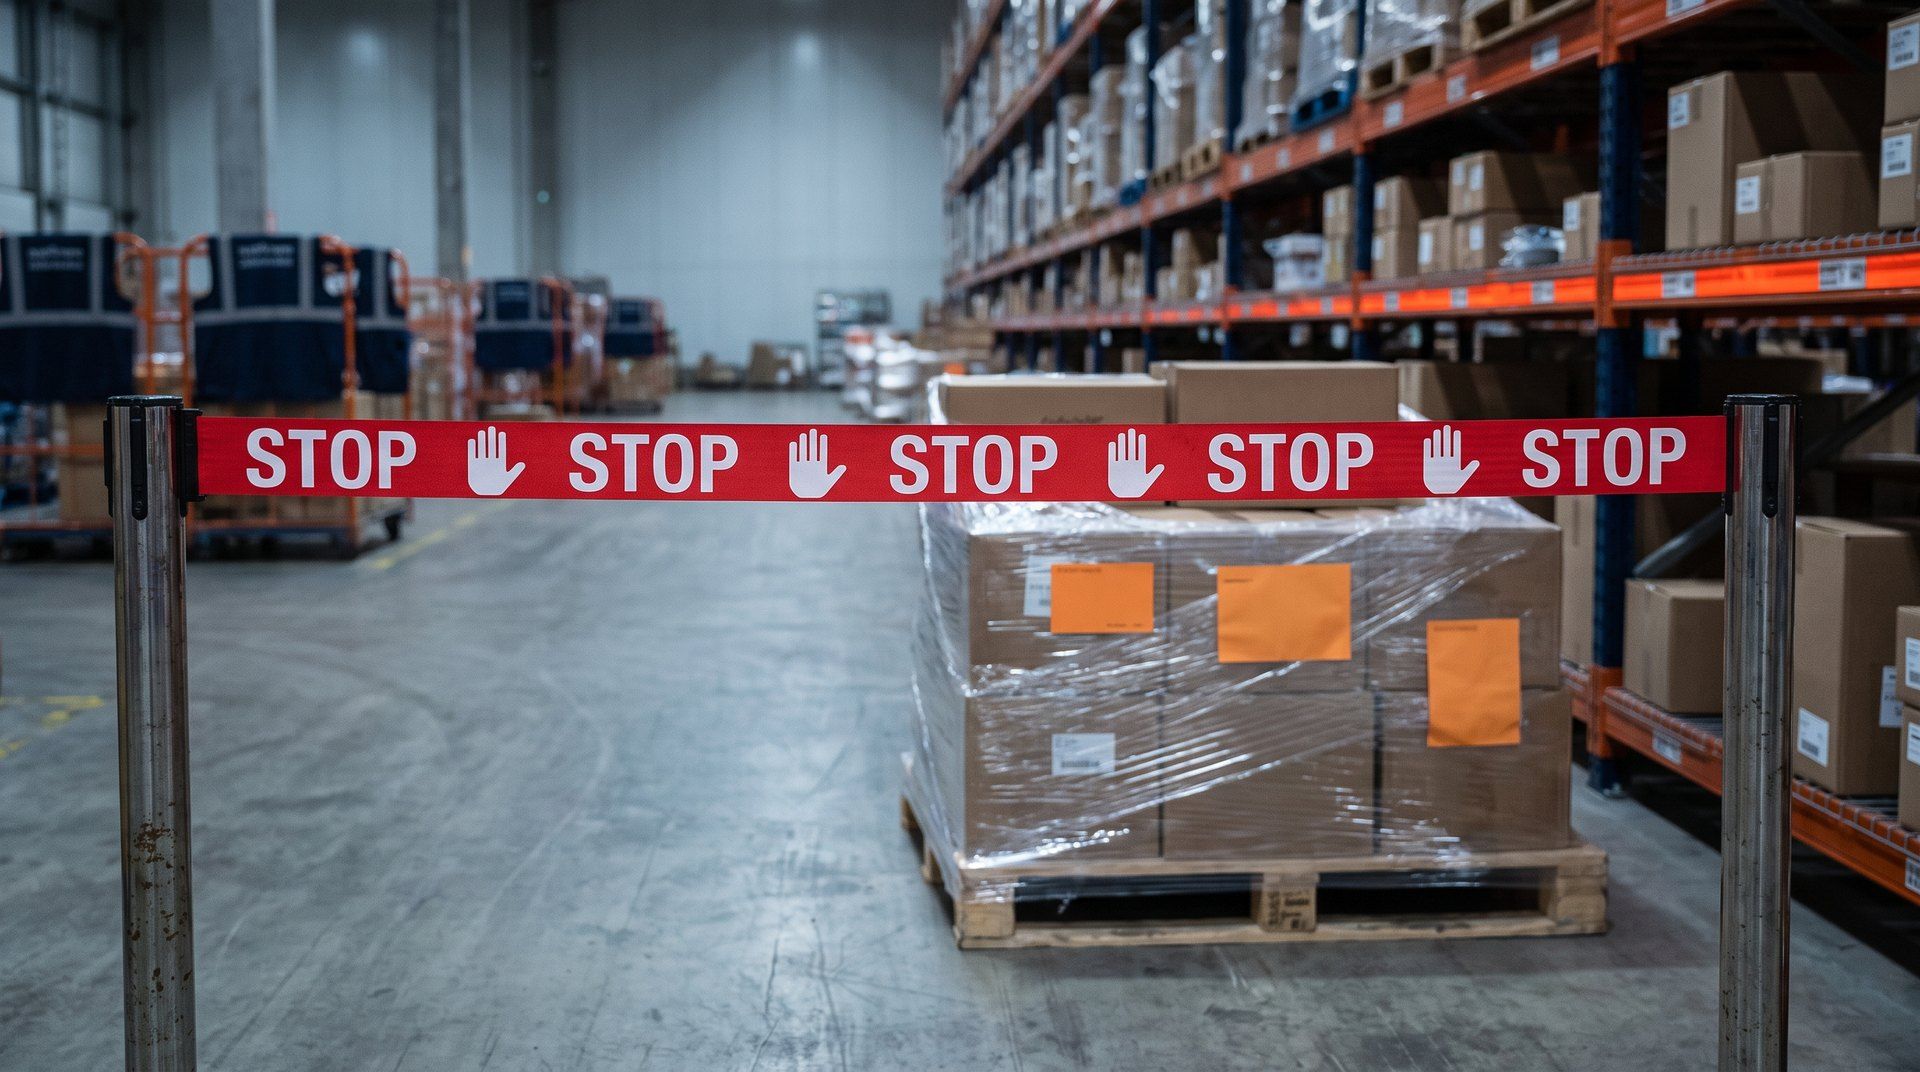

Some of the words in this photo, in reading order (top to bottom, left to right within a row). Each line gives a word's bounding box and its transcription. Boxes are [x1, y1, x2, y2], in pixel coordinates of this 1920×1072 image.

[246, 427, 417, 490] STOP
[568, 432, 739, 494] STOP
[889, 434, 1058, 495] STOP
[1207, 432, 1374, 493] STOP
[1522, 427, 1687, 487] STOP
